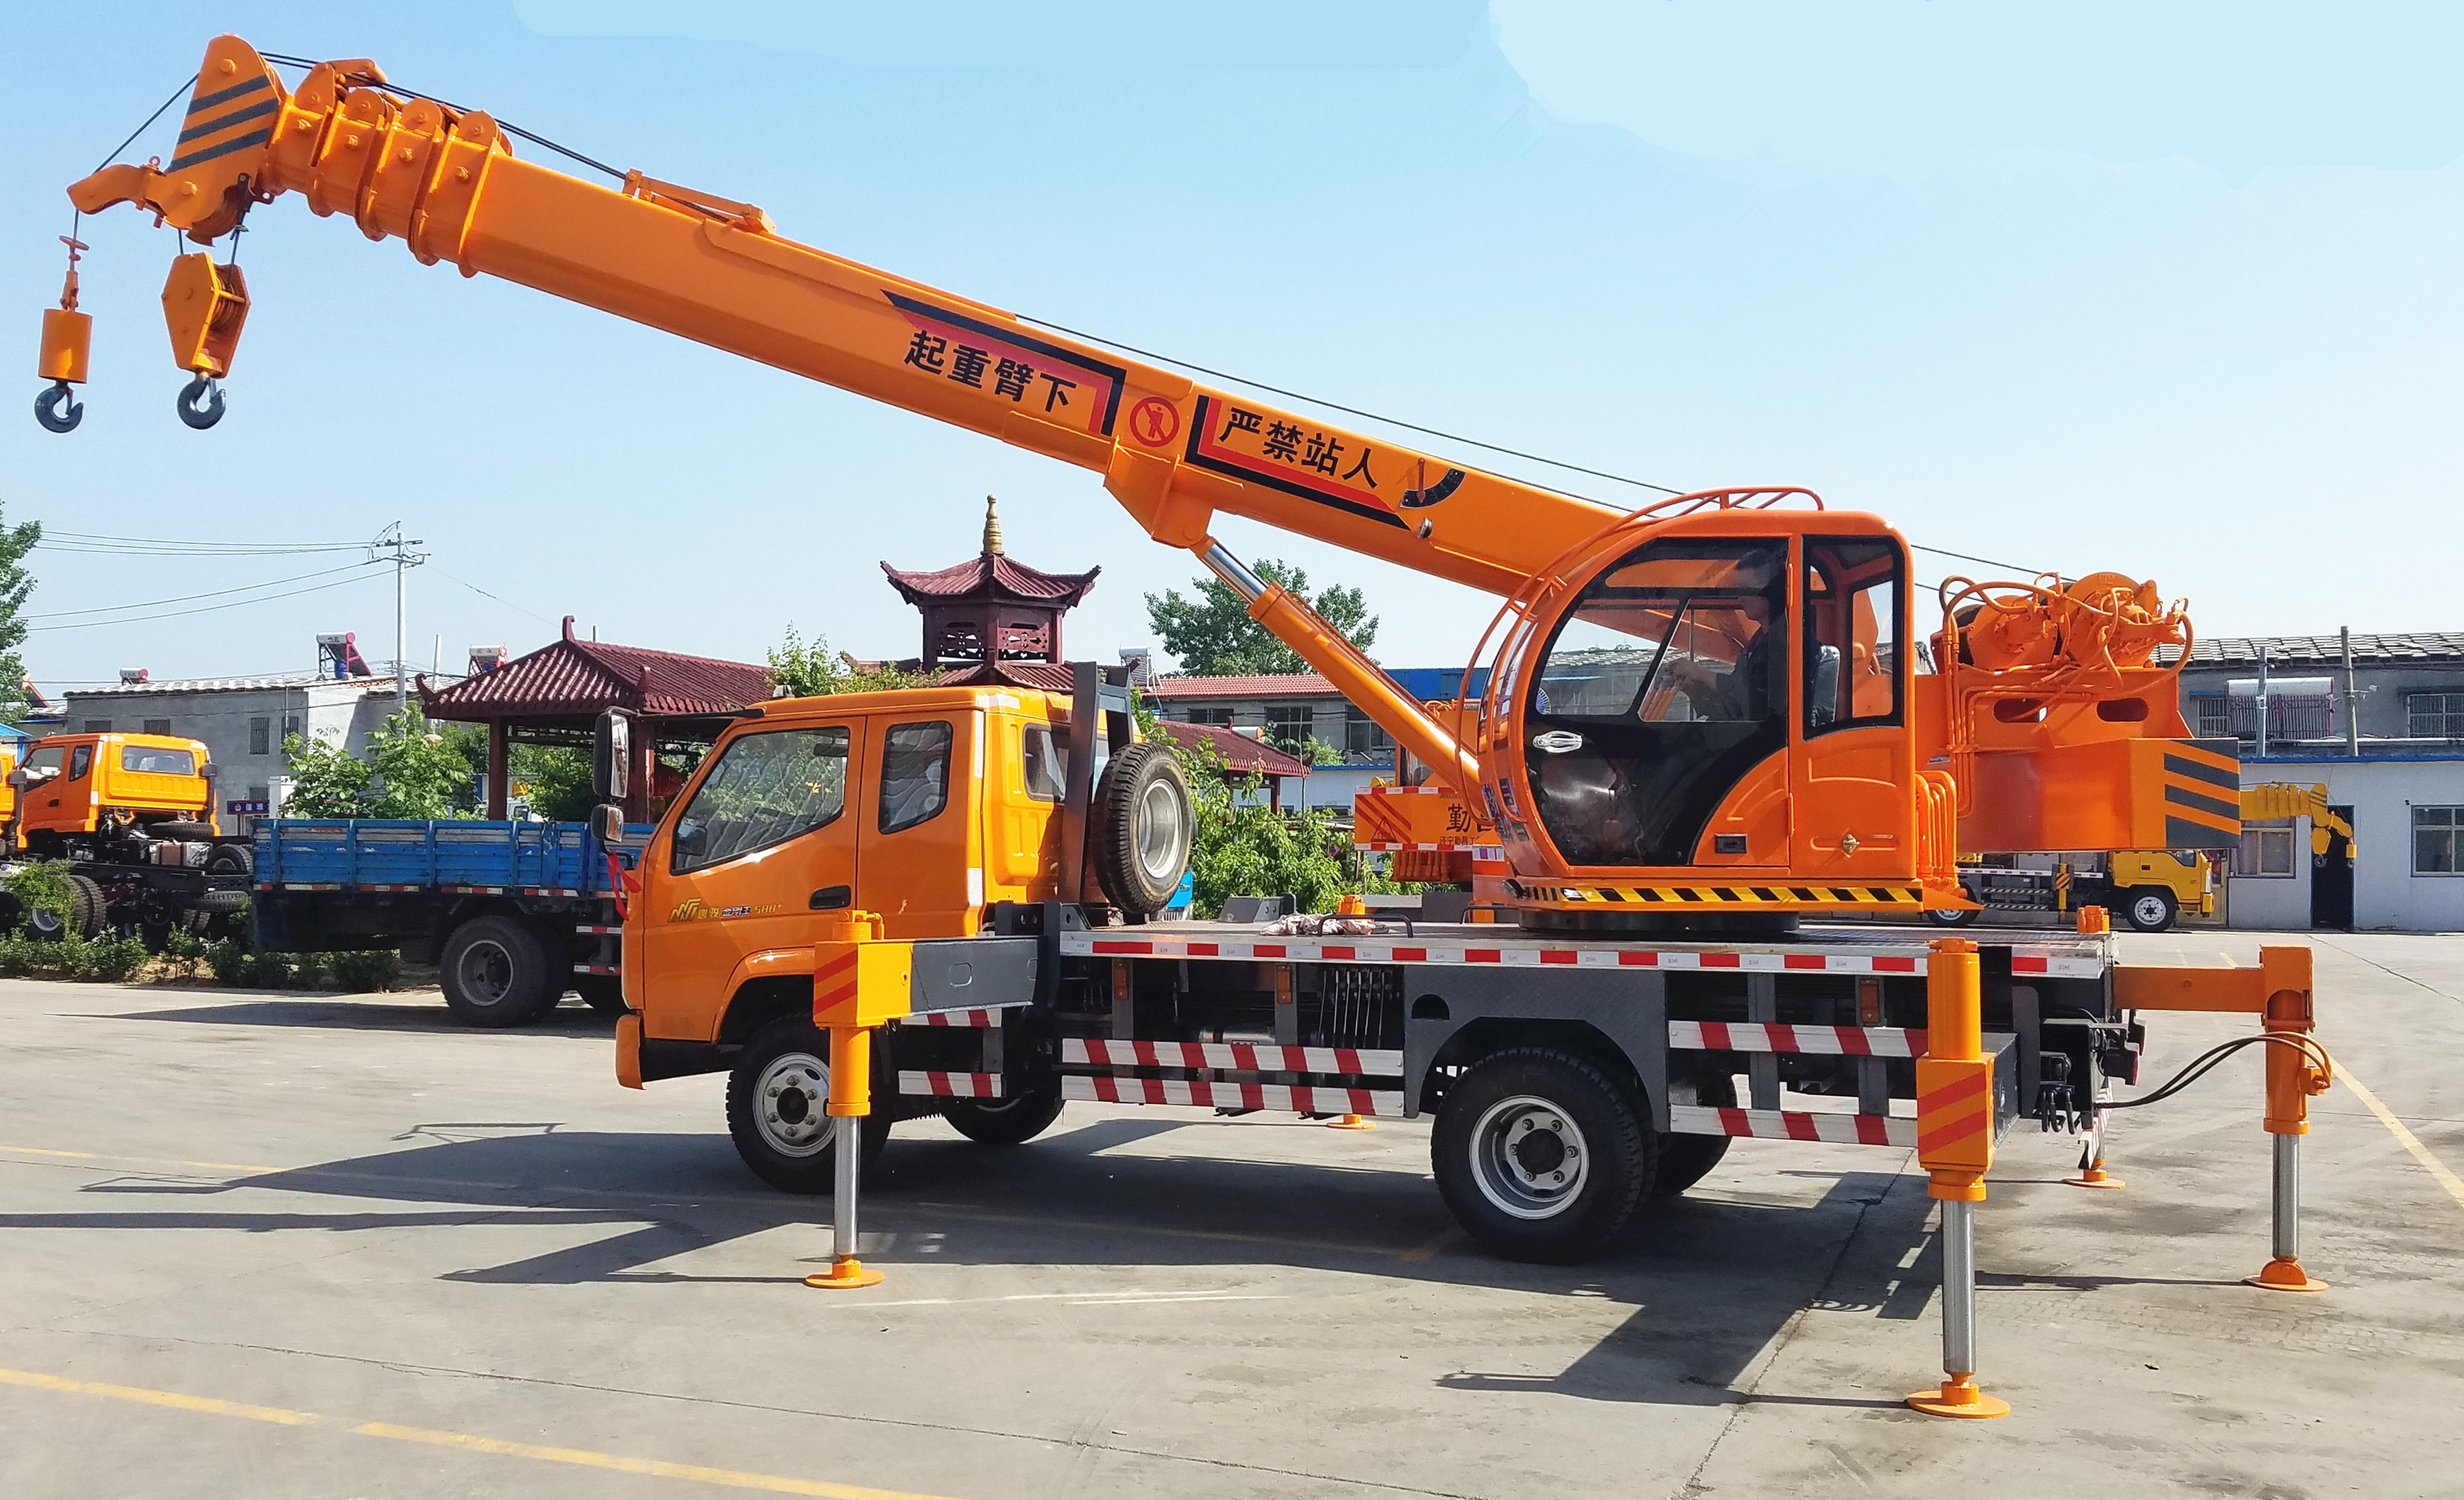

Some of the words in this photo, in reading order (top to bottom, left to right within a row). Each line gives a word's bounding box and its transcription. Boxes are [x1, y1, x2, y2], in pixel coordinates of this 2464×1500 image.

[904, 330, 1077, 413] 起重臂下
[1219, 407, 1378, 489] 严禁站人
[721, 905, 752, 918] 金刚王
